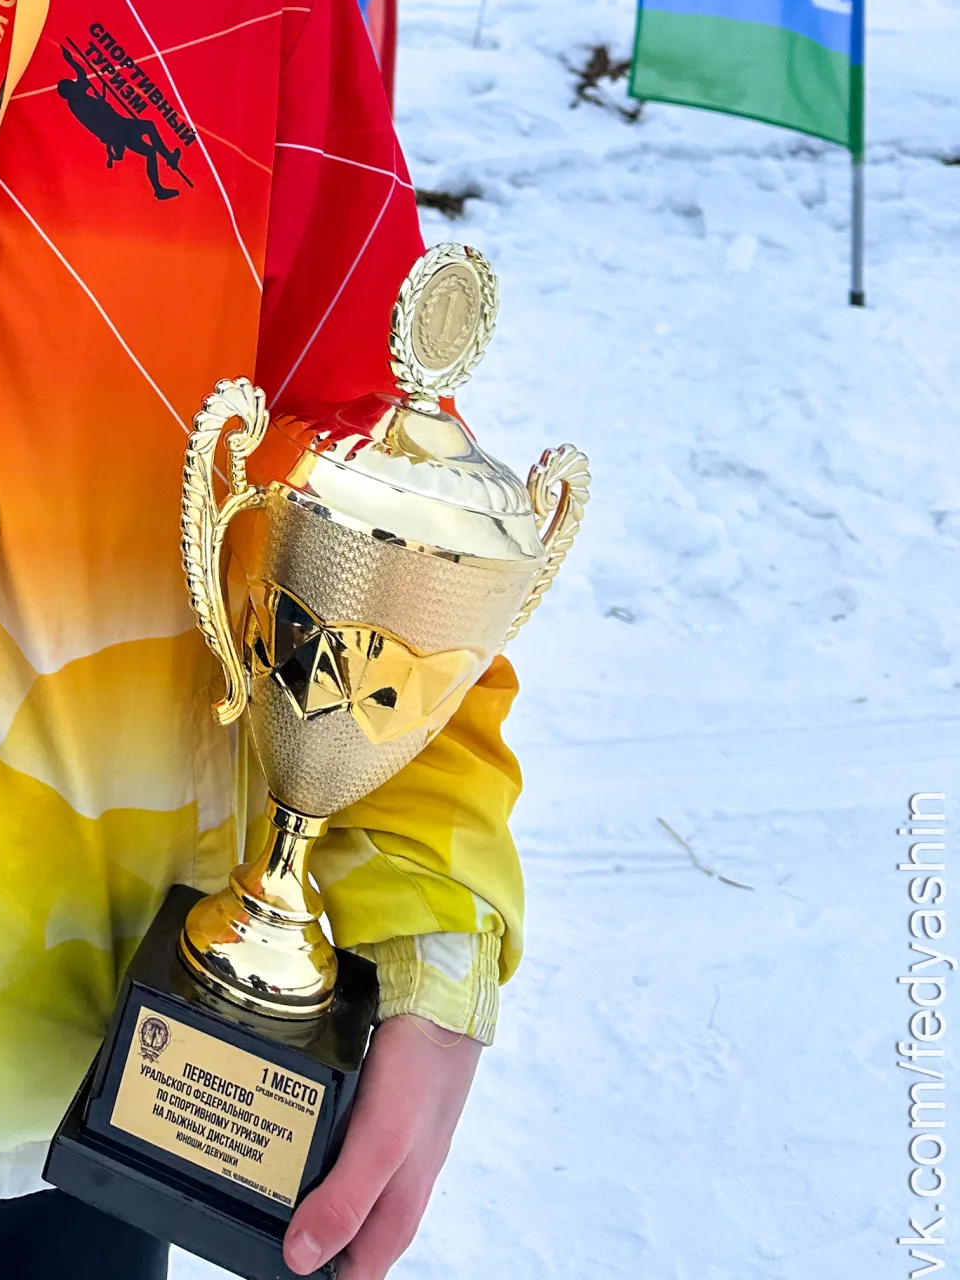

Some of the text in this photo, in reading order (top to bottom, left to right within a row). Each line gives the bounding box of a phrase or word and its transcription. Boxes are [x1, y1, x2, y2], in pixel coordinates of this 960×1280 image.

[85, 42, 149, 114] ТУРИЗМ
[89, 23, 197, 147] СПОРТИВНЫЙ
[139, 1063, 293, 1143] УРАЛЬСКОГО ФЕДЕРАЛЬНОГО ОКРУГА
[182, 1062, 254, 1107] ПЕРВЕНСТВО
[261, 1067, 319, 1106] 1 МЕСТО
[305, 1107, 315, 1116] РФ
[152, 1103, 264, 1163] НА ЛЫЖНЫХ ДИСТАНЦИЯХ
[156, 1087, 271, 1148] ПО СПОРТИВНОМУ ТУРИЗМУ
[176, 1130, 239, 1168] ЮНОШИ/ДЕВУШКИ
